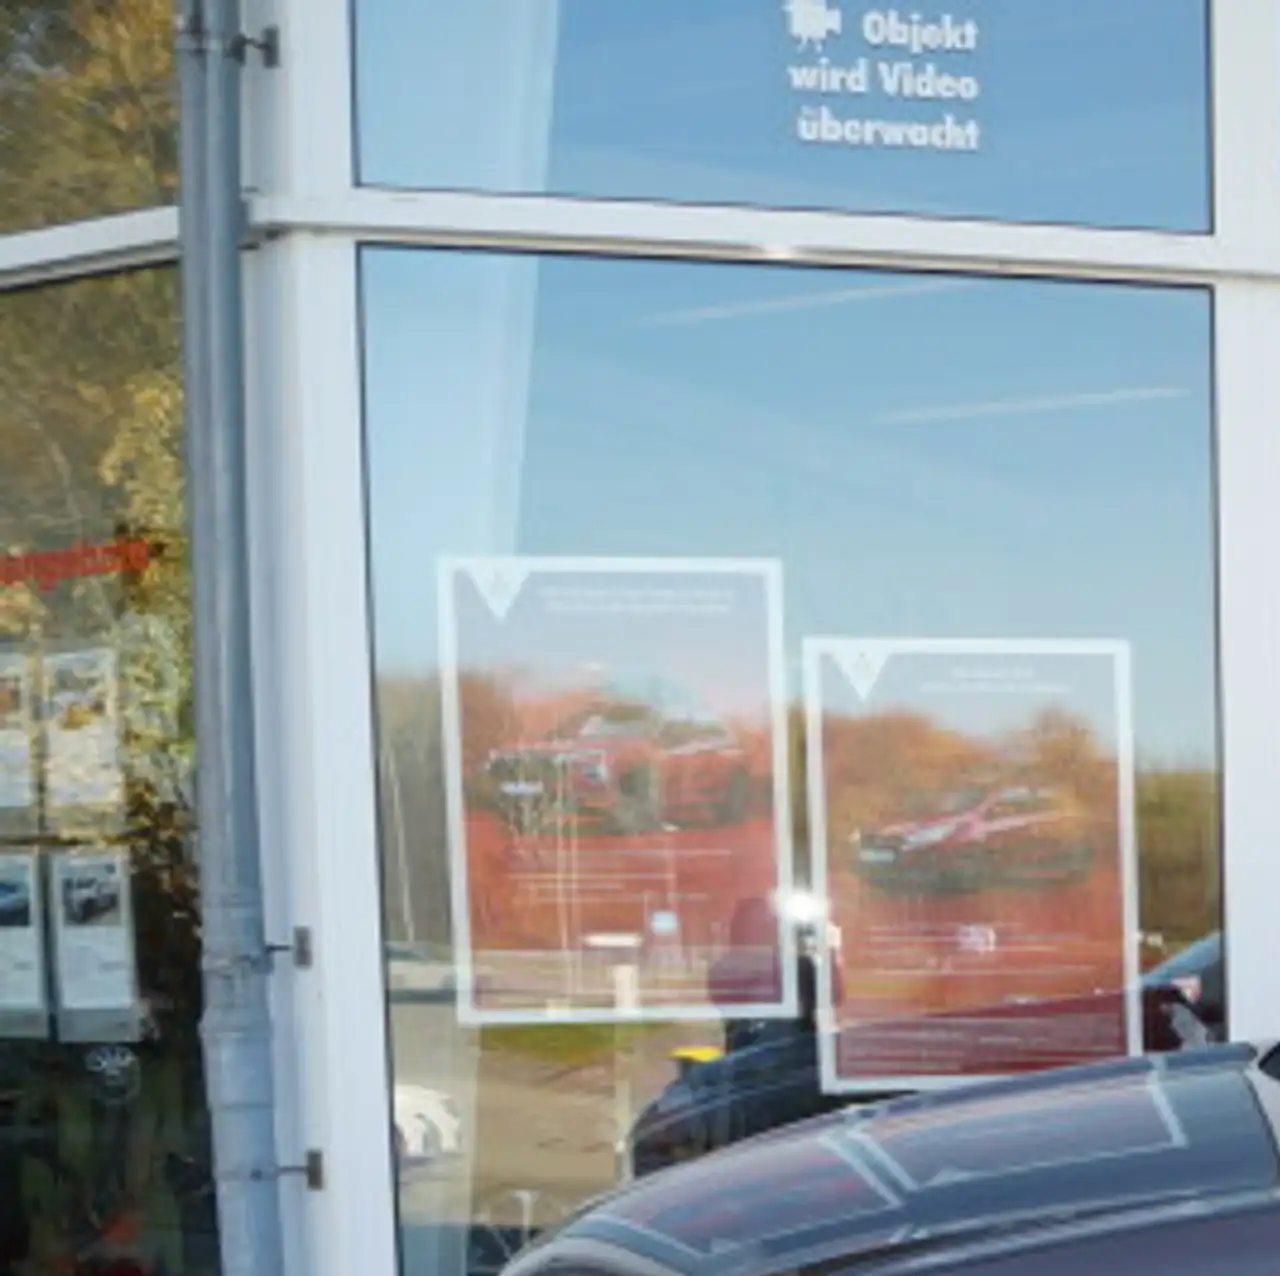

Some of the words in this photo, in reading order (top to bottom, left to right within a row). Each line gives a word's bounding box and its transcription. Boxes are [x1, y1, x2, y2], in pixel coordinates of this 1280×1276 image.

[863, 9, 979, 53] Objekt
[788, 58, 867, 95] wird
[878, 60, 979, 101] Video
[798, 106, 980, 150] überwacht
